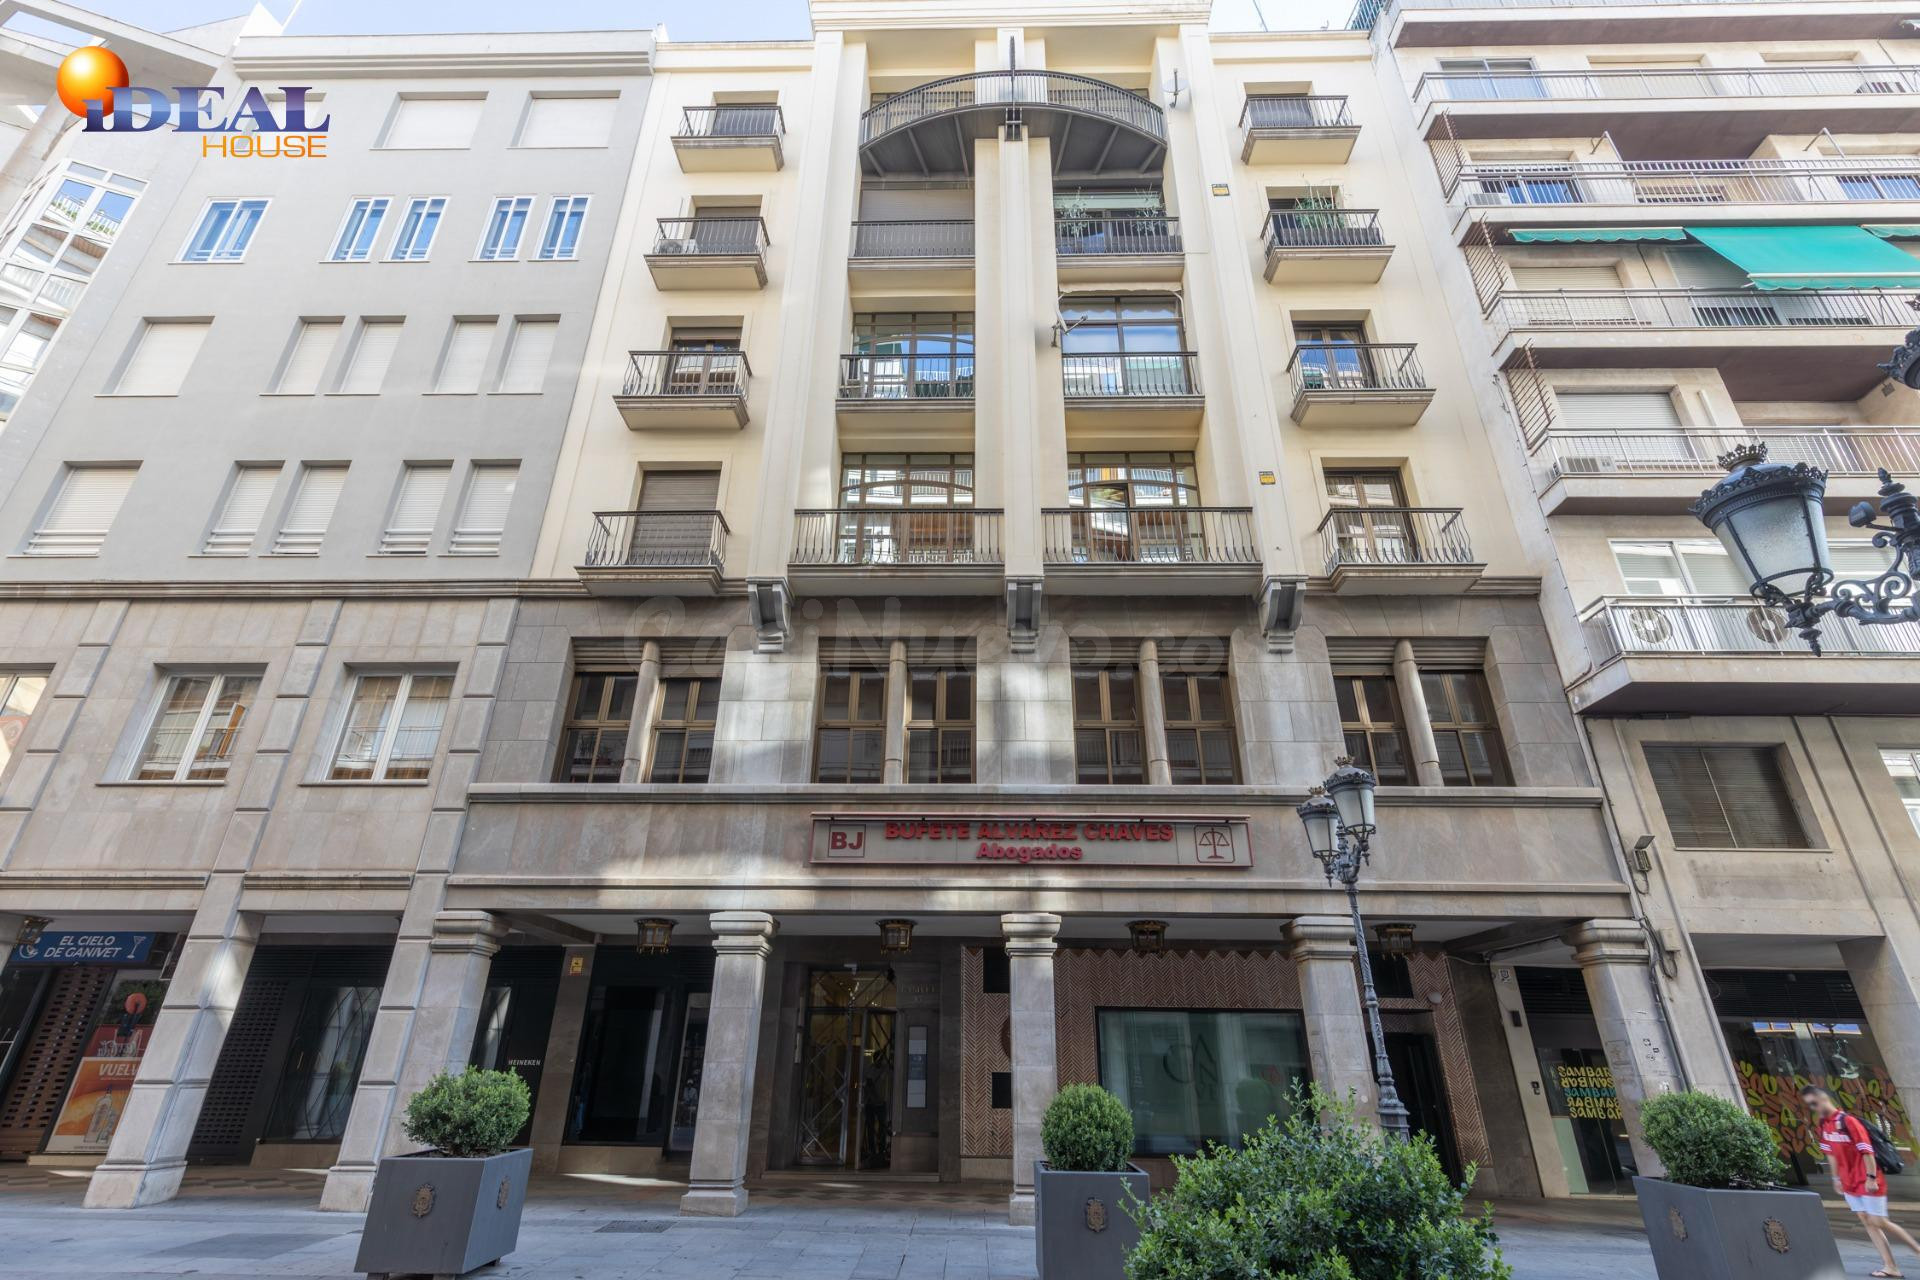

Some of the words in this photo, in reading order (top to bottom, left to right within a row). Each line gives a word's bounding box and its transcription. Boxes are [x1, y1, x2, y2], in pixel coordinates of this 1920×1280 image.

[831, 832, 863, 850] BJ
[885, 823, 970, 840] BUFETE
[1083, 824, 1174, 842] CHAVES
[976, 842, 1083, 863] Abogados
[59, 935, 75, 946] EL
[77, 935, 116, 946] CIELO
[44, 947, 62, 958] DE
[64, 947, 122, 958] GANIVET
